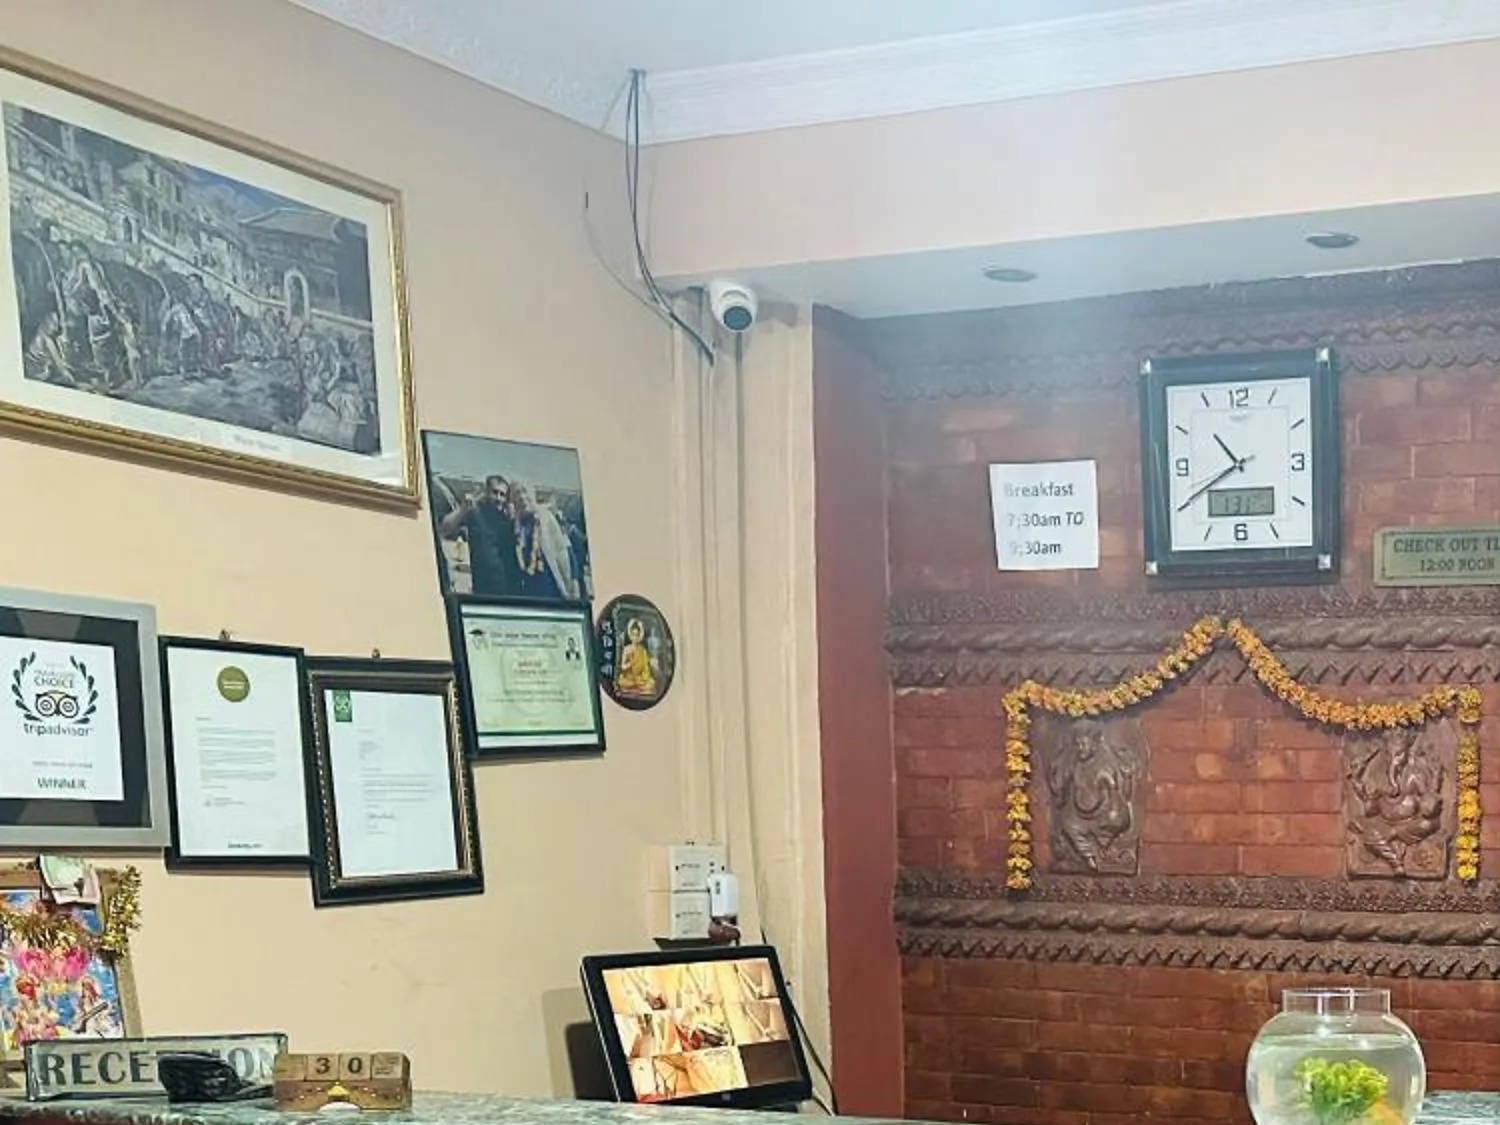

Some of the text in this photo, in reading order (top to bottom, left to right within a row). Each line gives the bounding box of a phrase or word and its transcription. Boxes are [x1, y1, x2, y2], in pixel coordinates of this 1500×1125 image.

[1229, 387, 1249, 408] 12
[1175, 458, 1189, 477] 9
[1291, 453, 1305, 471] 3
[1004, 481, 1074, 497] Breakfast
[1065, 511, 1084, 525] TO
[1233, 523, 1249, 541] 6
[1394, 538, 1446, 553] CHECK
[1450, 537, 1480, 551] OUT
[1421, 558, 1495, 572] 12:00 NOON
[23, 722, 90, 737] tripadvisor
[37, 776, 86, 790] WINNER
